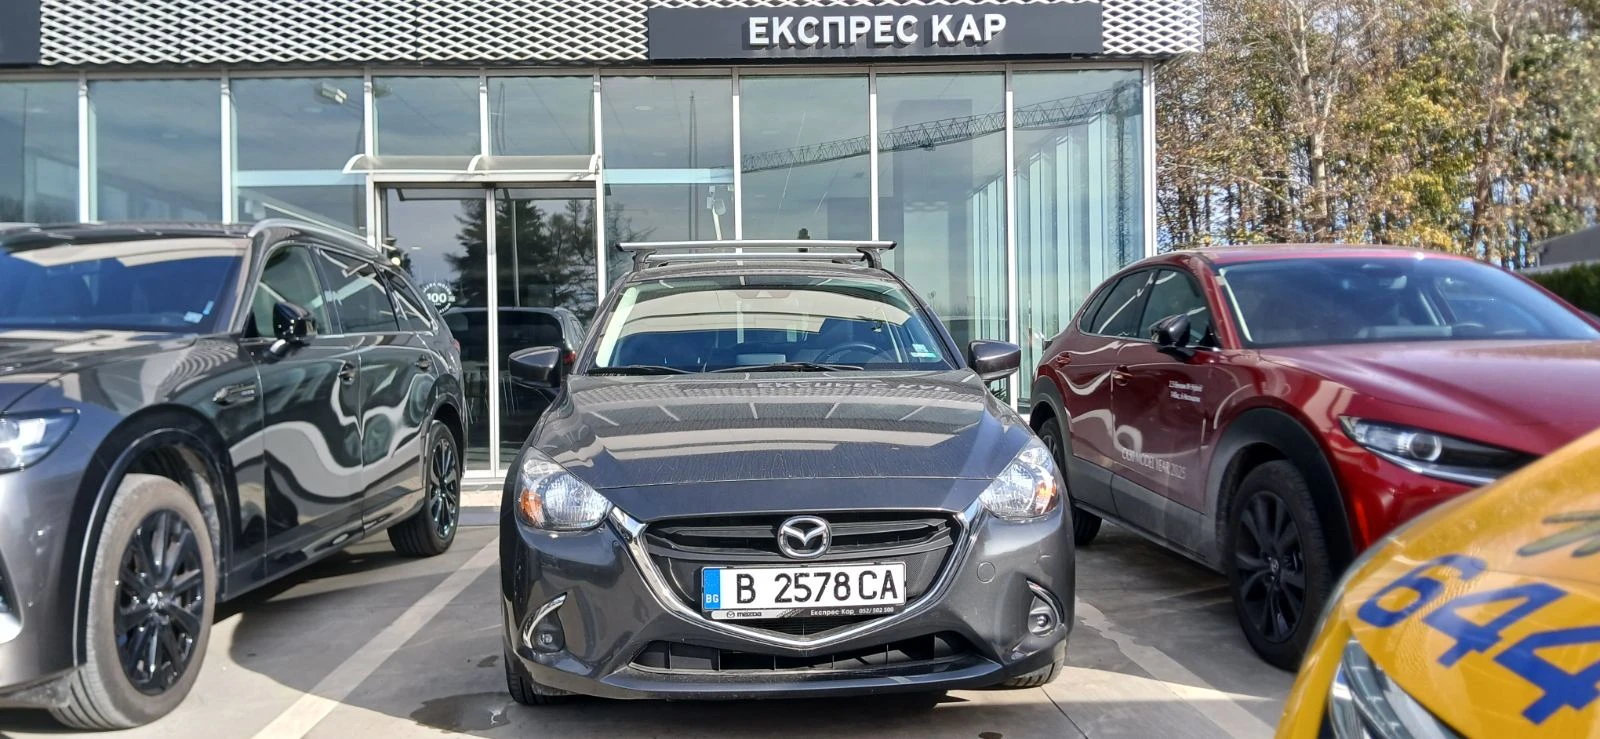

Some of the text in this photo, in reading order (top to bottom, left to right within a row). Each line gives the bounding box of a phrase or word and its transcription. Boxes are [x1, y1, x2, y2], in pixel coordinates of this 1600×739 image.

[749, 13, 1007, 45] ЕКСПРЕС КАР
[427, 293, 447, 303] 100
[736, 569, 898, 604] B 2578 CA
[705, 593, 719, 603] BG
